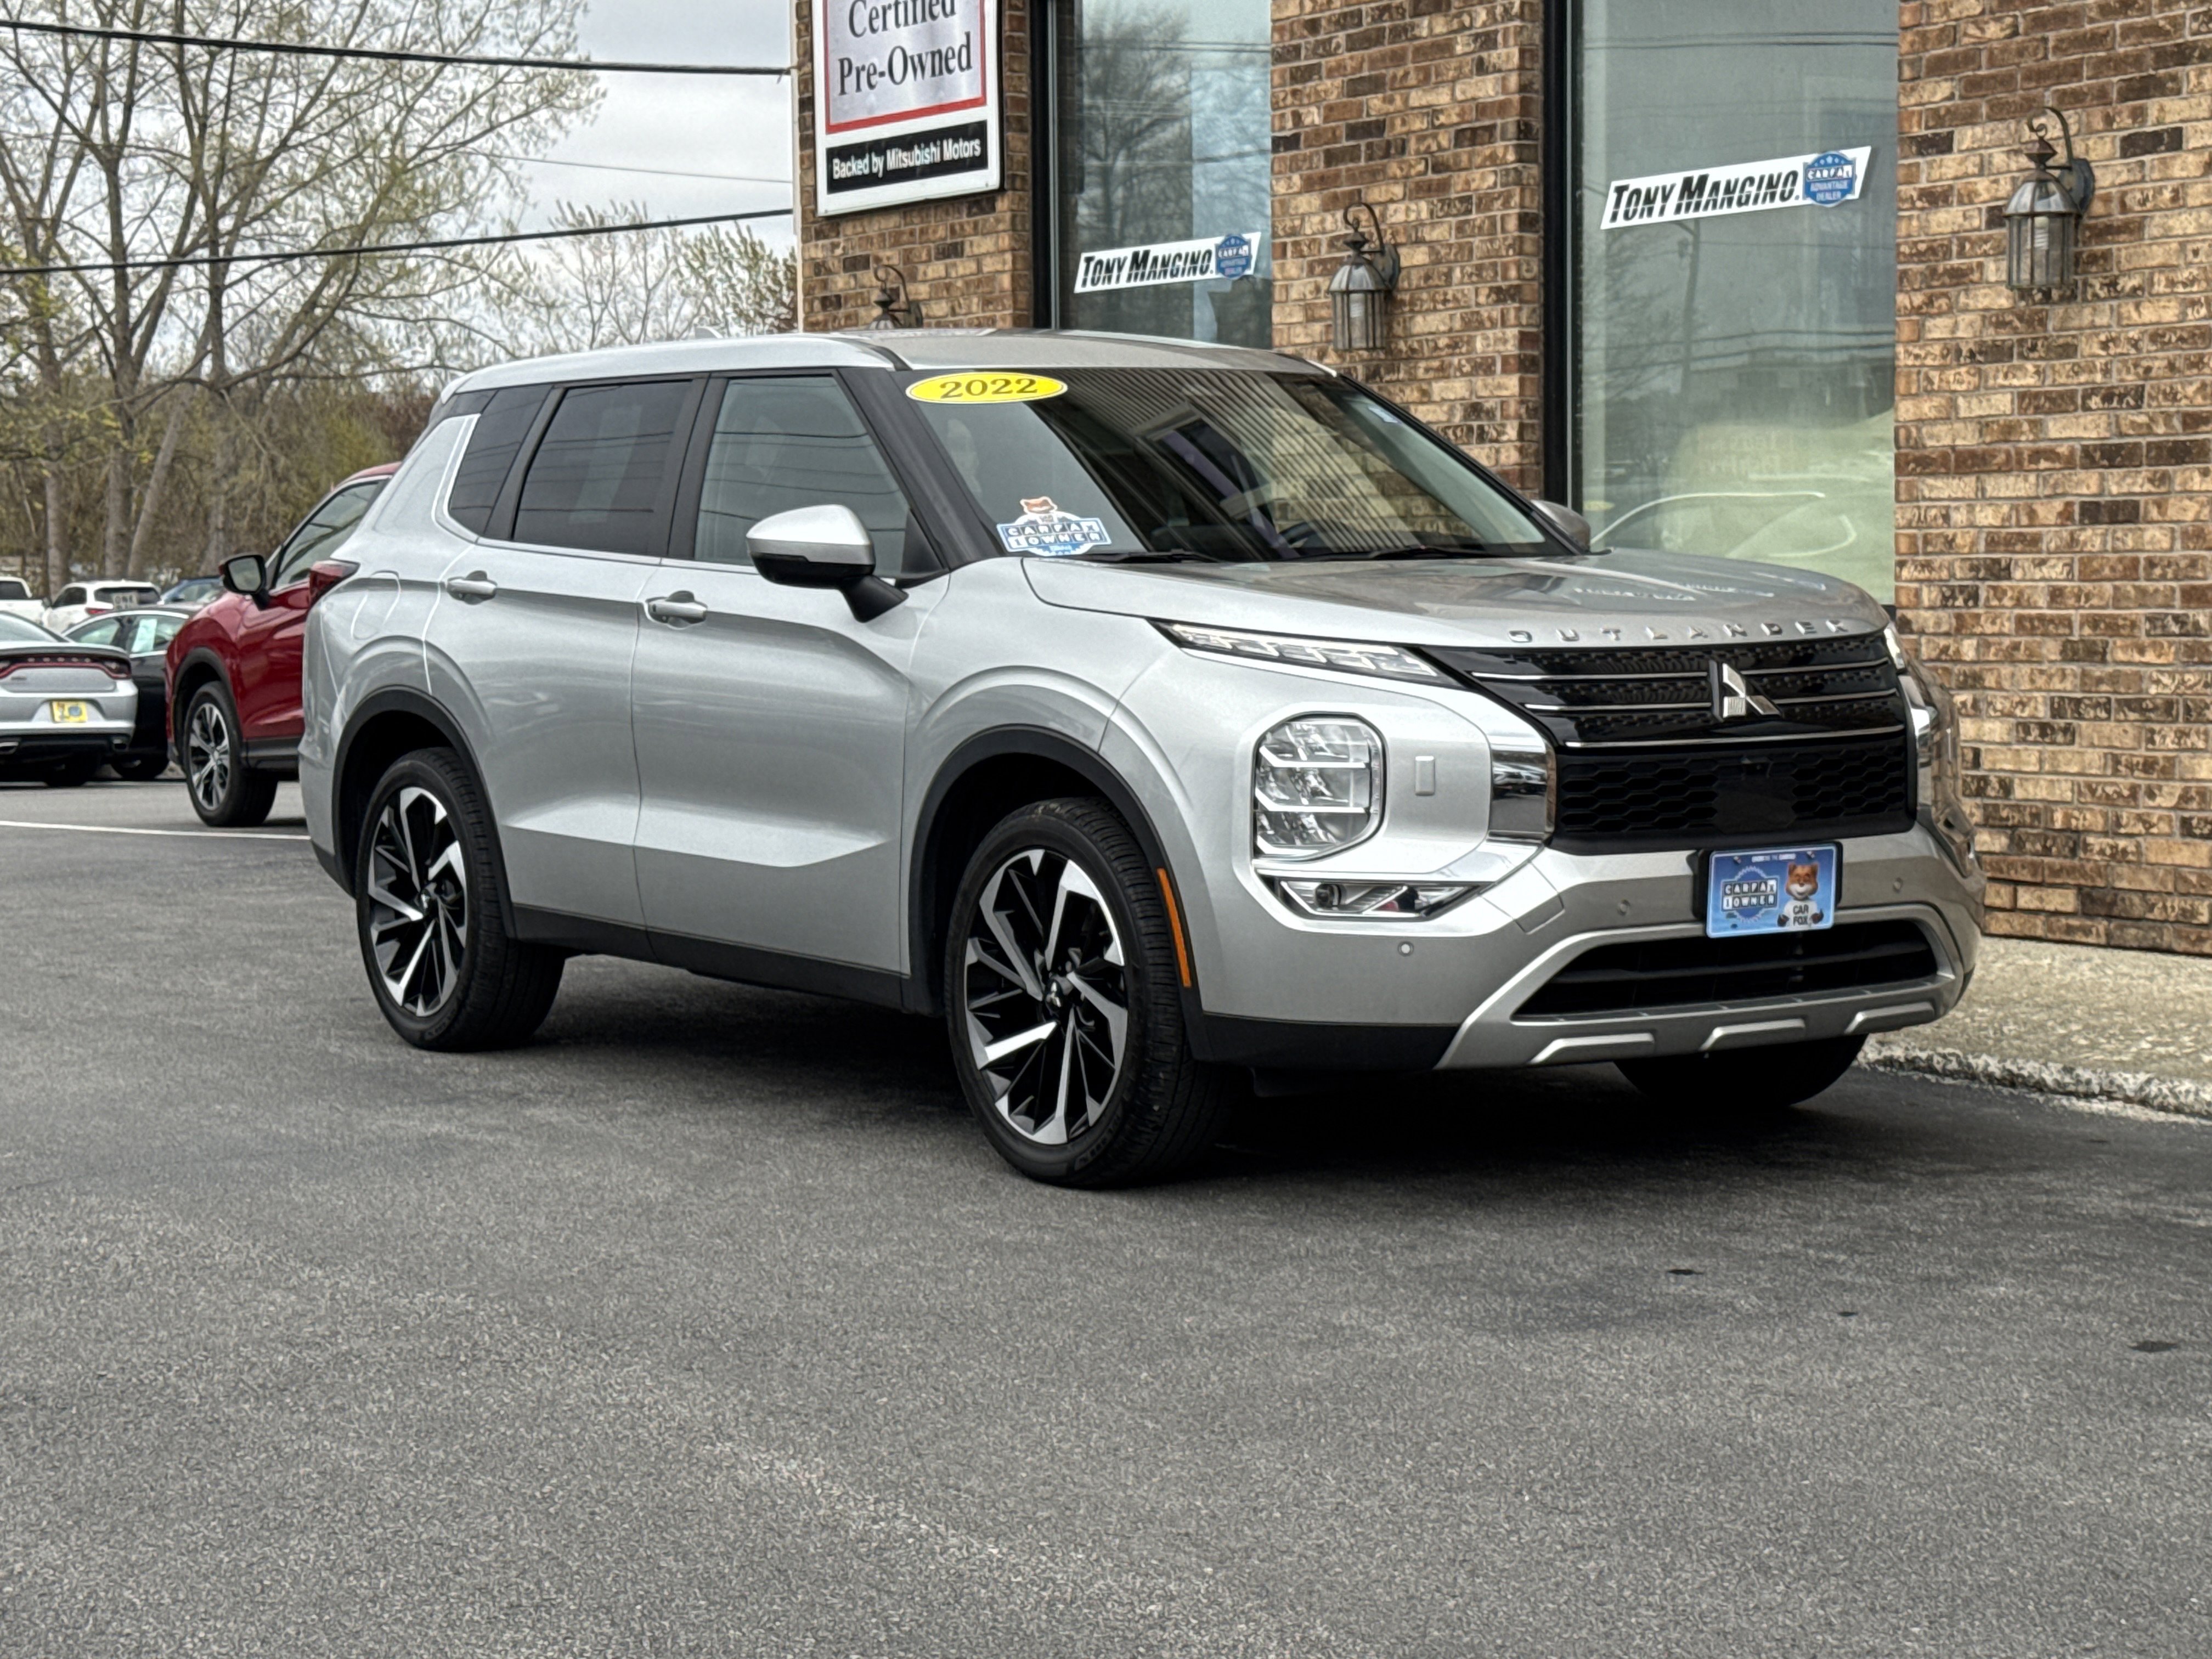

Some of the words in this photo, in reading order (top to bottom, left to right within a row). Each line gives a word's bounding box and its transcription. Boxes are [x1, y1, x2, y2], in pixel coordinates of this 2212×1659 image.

[838, 31, 973, 96] Pre-Owned
[832, 153, 870, 180] Backed
[871, 153, 885, 178] by
[886, 140, 941, 172] Mitsubishi
[943, 138, 981, 161] Motors
[1609, 183, 1676, 223] TONY
[1081, 255, 1127, 288] TONY
[939, 378, 1039, 399] 2022
[1007, 522, 1100, 537] CARFAX
[1508, 619, 1848, 643] OUTLANDER
[1724, 881, 1776, 894] CARFAX
[1733, 894, 1775, 907] OWNER
[1793, 904, 1809, 915] CAR
[1793, 916, 1809, 926] FOX
